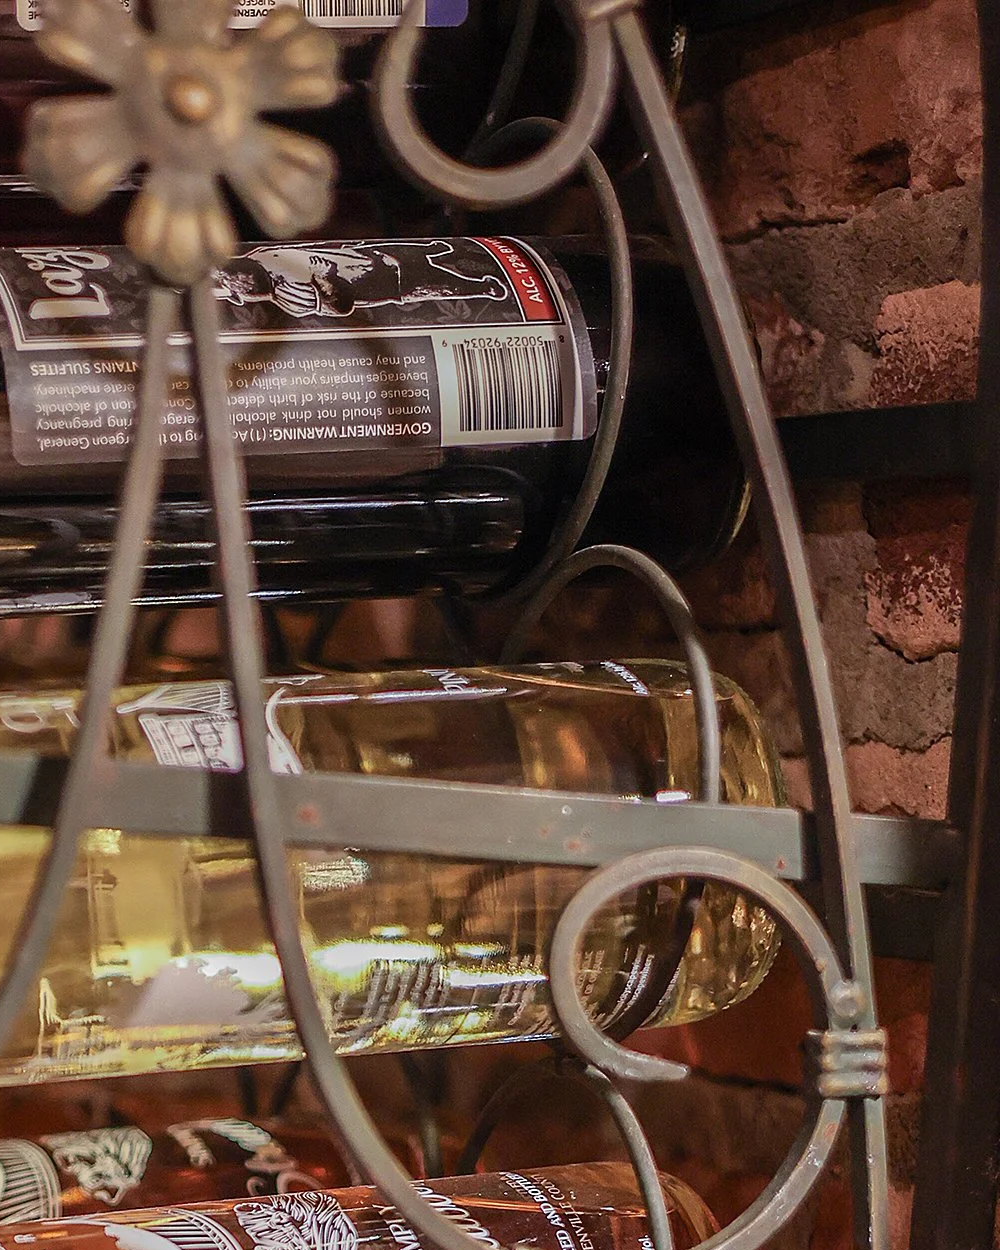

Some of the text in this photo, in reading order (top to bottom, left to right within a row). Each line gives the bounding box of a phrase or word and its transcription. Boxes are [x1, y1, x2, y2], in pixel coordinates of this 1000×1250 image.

[507, 254, 528, 275] 12%
[522, 275, 543, 303] ALC.
[441, 334, 565, 349] 8 50022 92034 9
[31, 355, 426, 376] and may cause health problems. NTAINS SULFITES
[236, 378, 249, 390] to
[252, 376, 287, 390] ability
[290, 374, 318, 387] your
[319, 374, 363, 388] impairs
[366, 370, 428, 385] beverages
[33, 384, 100, 397] machinery,
[104, 383, 135, 395] erate
[381, 389, 430, 401] because
[227, 396, 265, 407] defect
[270, 394, 297, 407] birth
[300, 394, 313, 405] of
[318, 393, 337, 404] risk
[342, 392, 361, 403] the
[365, 391, 376, 402] of
[35, 403, 91, 415] alcoholic
[95, 402, 107, 415] of
[318, 409, 336, 421] not
[388, 405, 431, 418] women
[108, 416, 132, 428] ring
[229, 412, 277, 425] alcoholi
[282, 411, 312, 423] drink
[343, 408, 382, 423] should
[37, 418, 101, 431] pregnancy
[339, 422, 431, 437] GOVERNMENT
[93, 432, 130, 447] rgeon
[170, 433, 182, 444] to
[250, 428, 267, 441] (1)
[269, 427, 337, 441] WARNING:
[540, 1202, 565, 1228] AND
